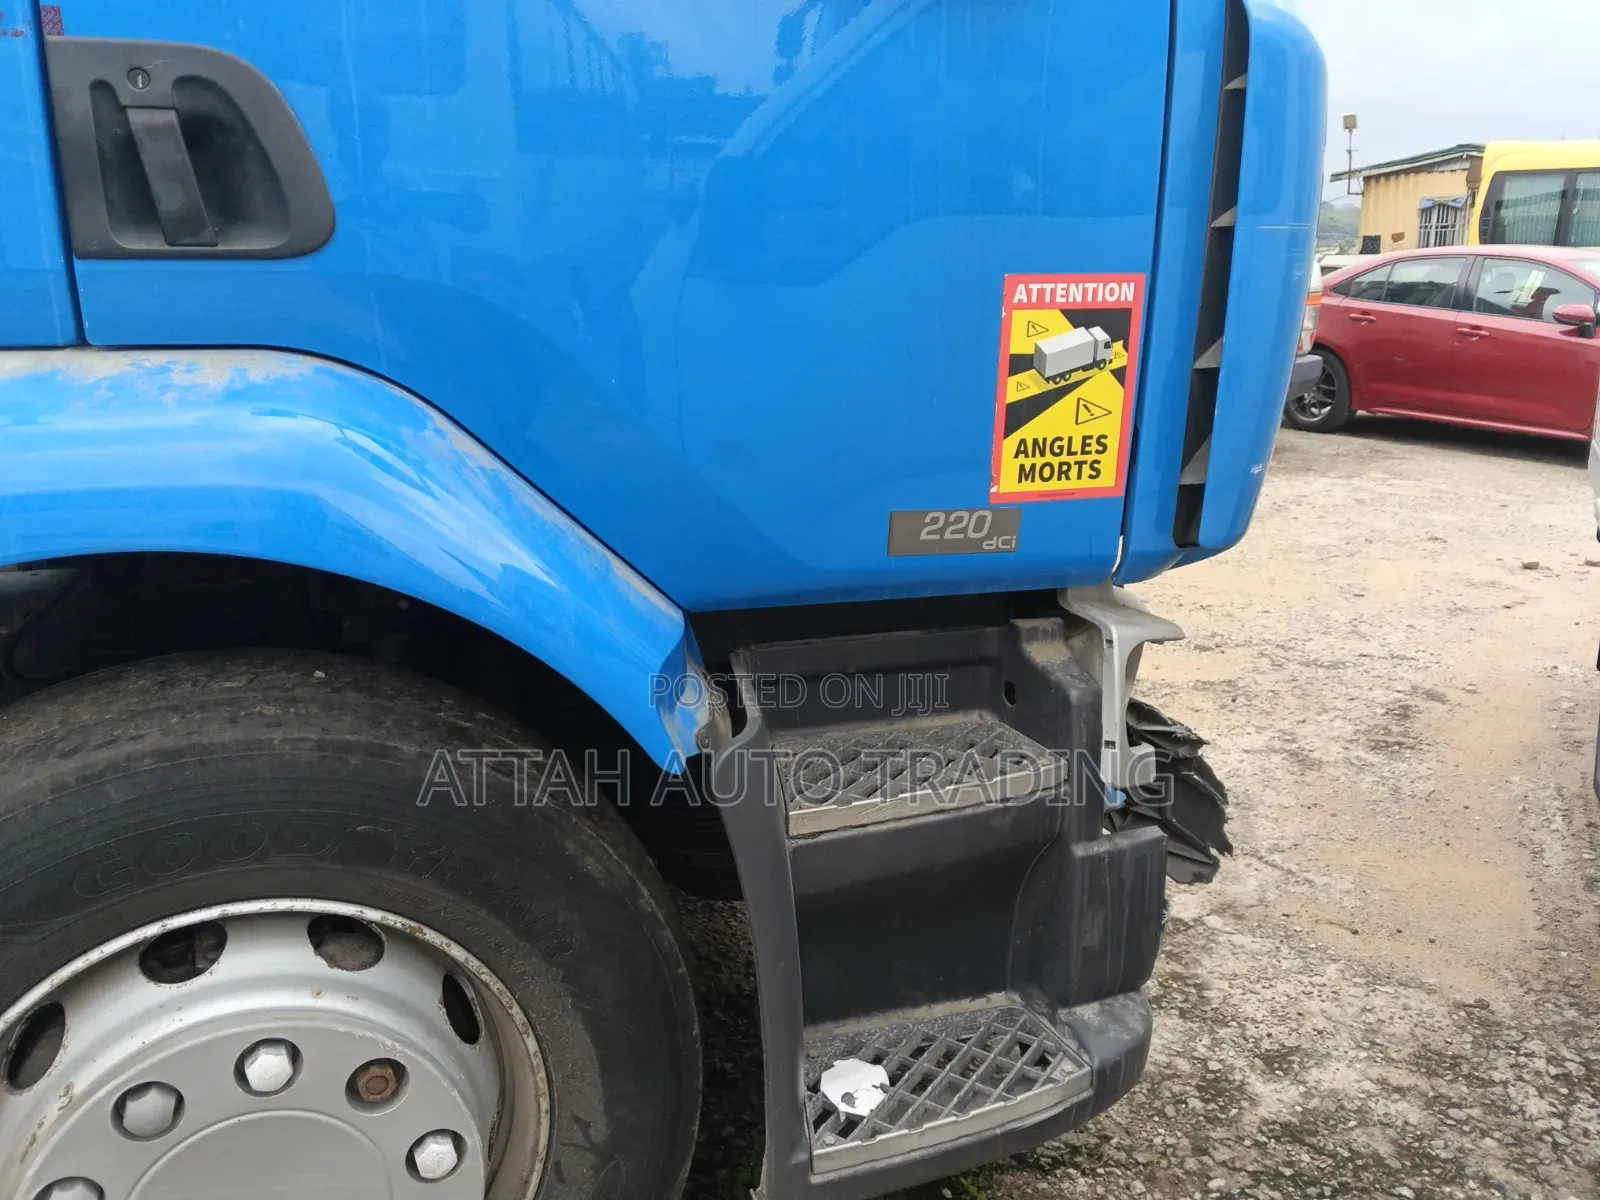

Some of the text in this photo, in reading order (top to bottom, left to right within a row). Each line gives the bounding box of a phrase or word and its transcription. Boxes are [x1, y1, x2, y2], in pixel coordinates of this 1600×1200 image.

[1012, 281, 1136, 304] ATTENTION
[1013, 433, 1109, 460] ANGLES
[1017, 459, 1102, 484] MORTS
[919, 509, 993, 541] 220
